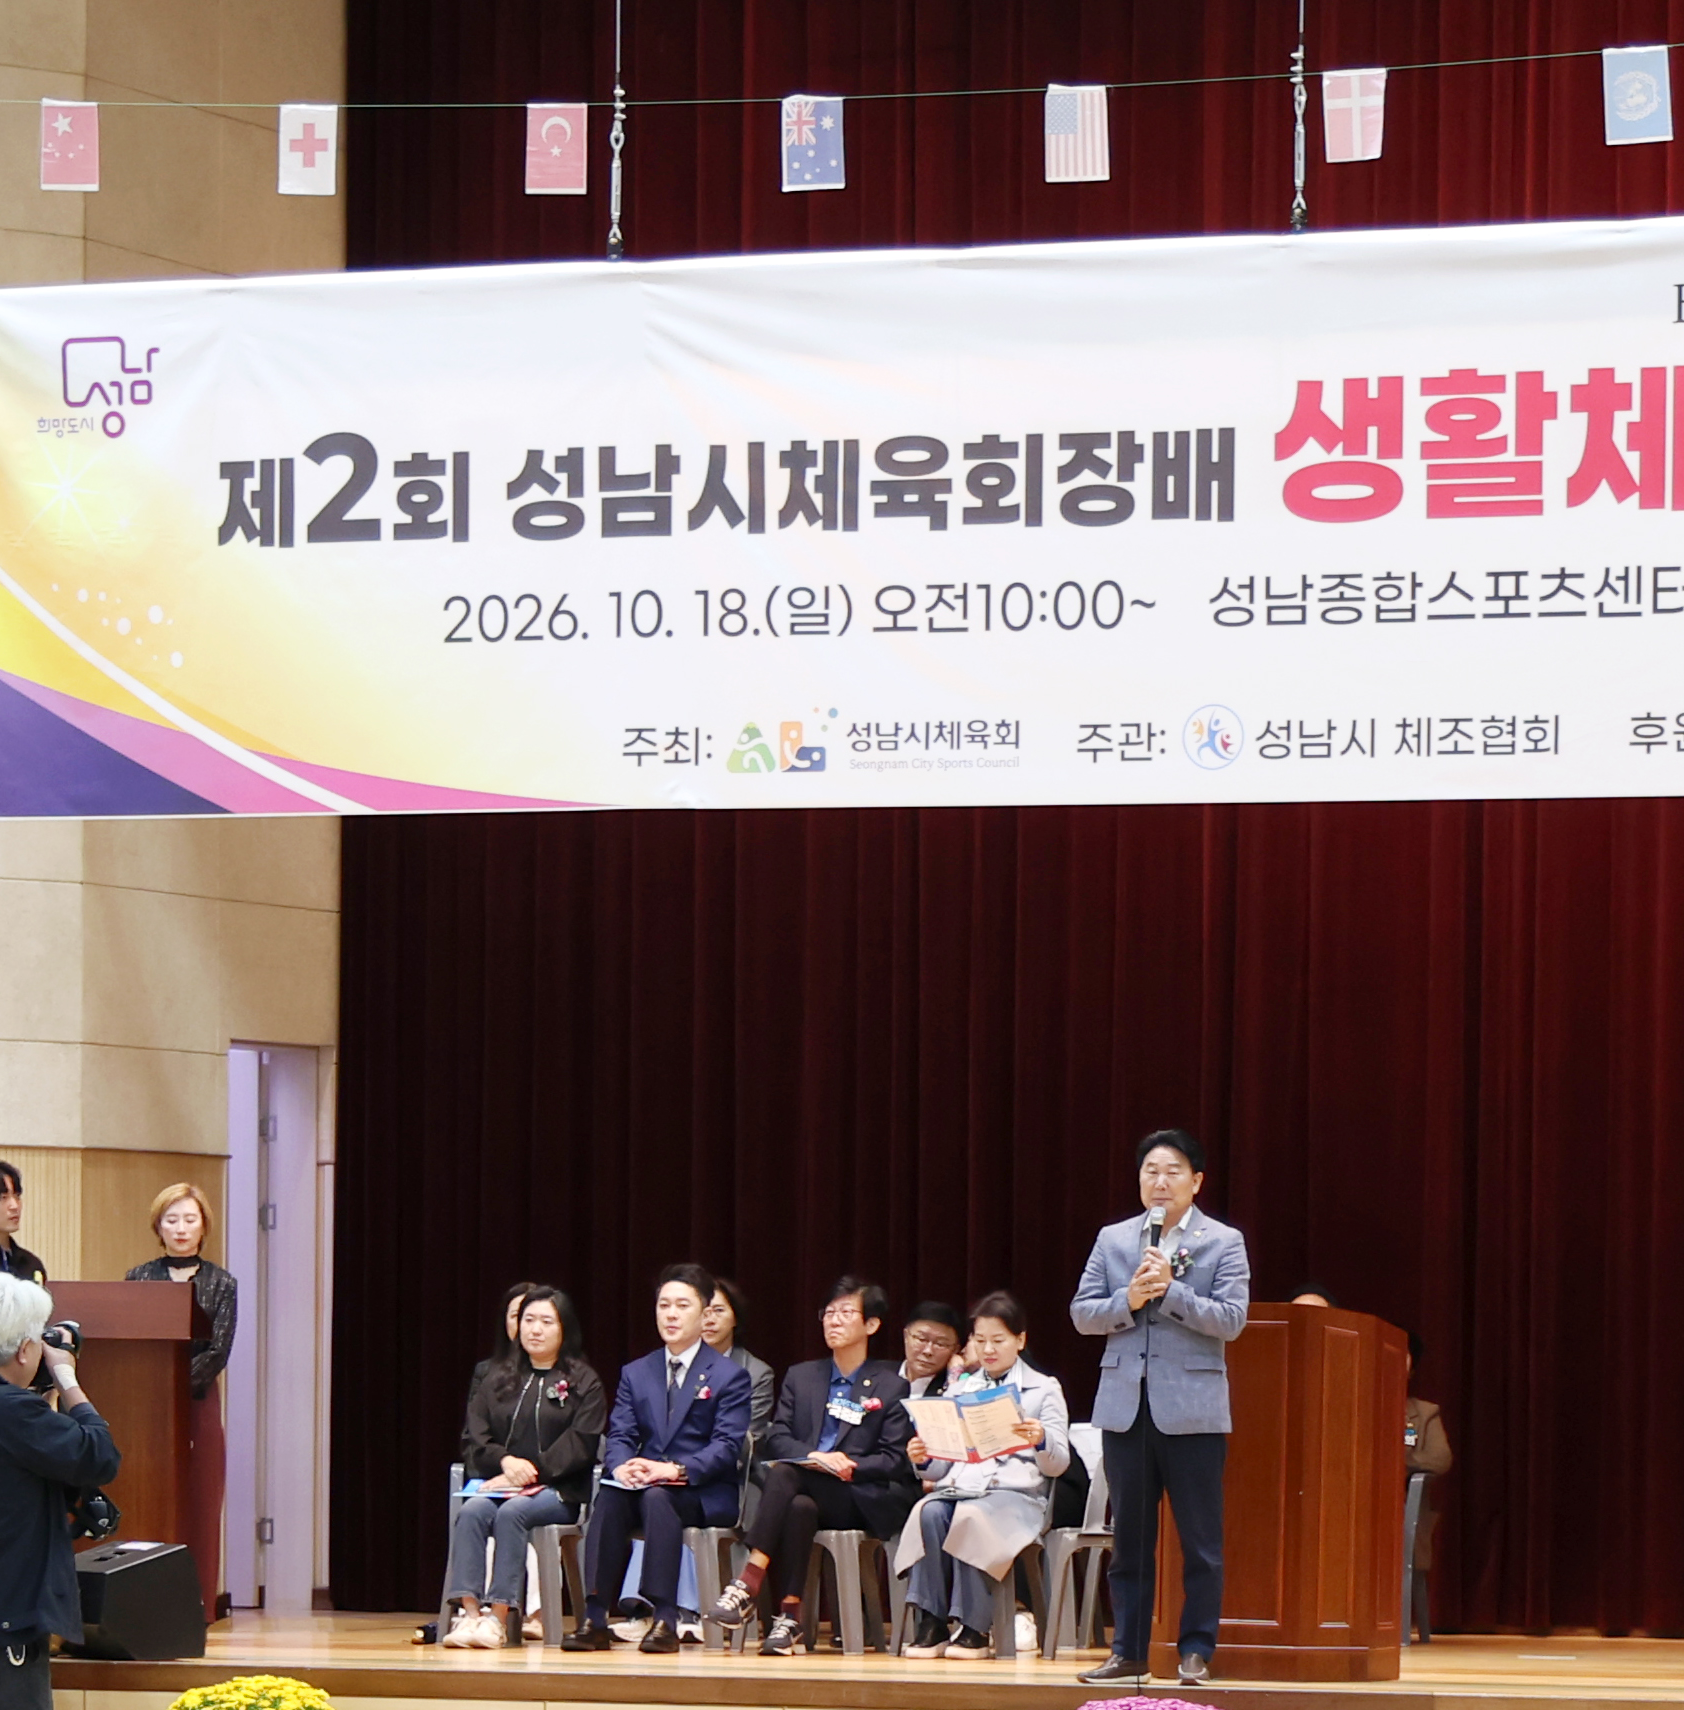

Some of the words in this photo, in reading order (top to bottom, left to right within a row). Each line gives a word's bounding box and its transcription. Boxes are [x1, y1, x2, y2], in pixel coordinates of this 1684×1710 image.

[36, 417, 94, 438] 희망도시
[217, 432, 471, 548] 제2회
[505, 427, 1236, 543] 성남시체육회장배
[443, 594, 589, 644] 2026.
[607, 590, 675, 641] 10.
[696, 585, 853, 638] 18.(일)
[872, 580, 1157, 636] 오전10:00~
[622, 726, 713, 767] 주최:
[846, 719, 1021, 752] 성남시체육회
[1076, 720, 1167, 764] 주관:
[1254, 714, 1377, 761] 성남시
[1393, 713, 1562, 760] 체조협회
[849, 757, 908, 772] Seongnam
[912, 757, 934, 771] City
[937, 757, 974, 771] Sports
[976, 755, 1020, 770] Council
